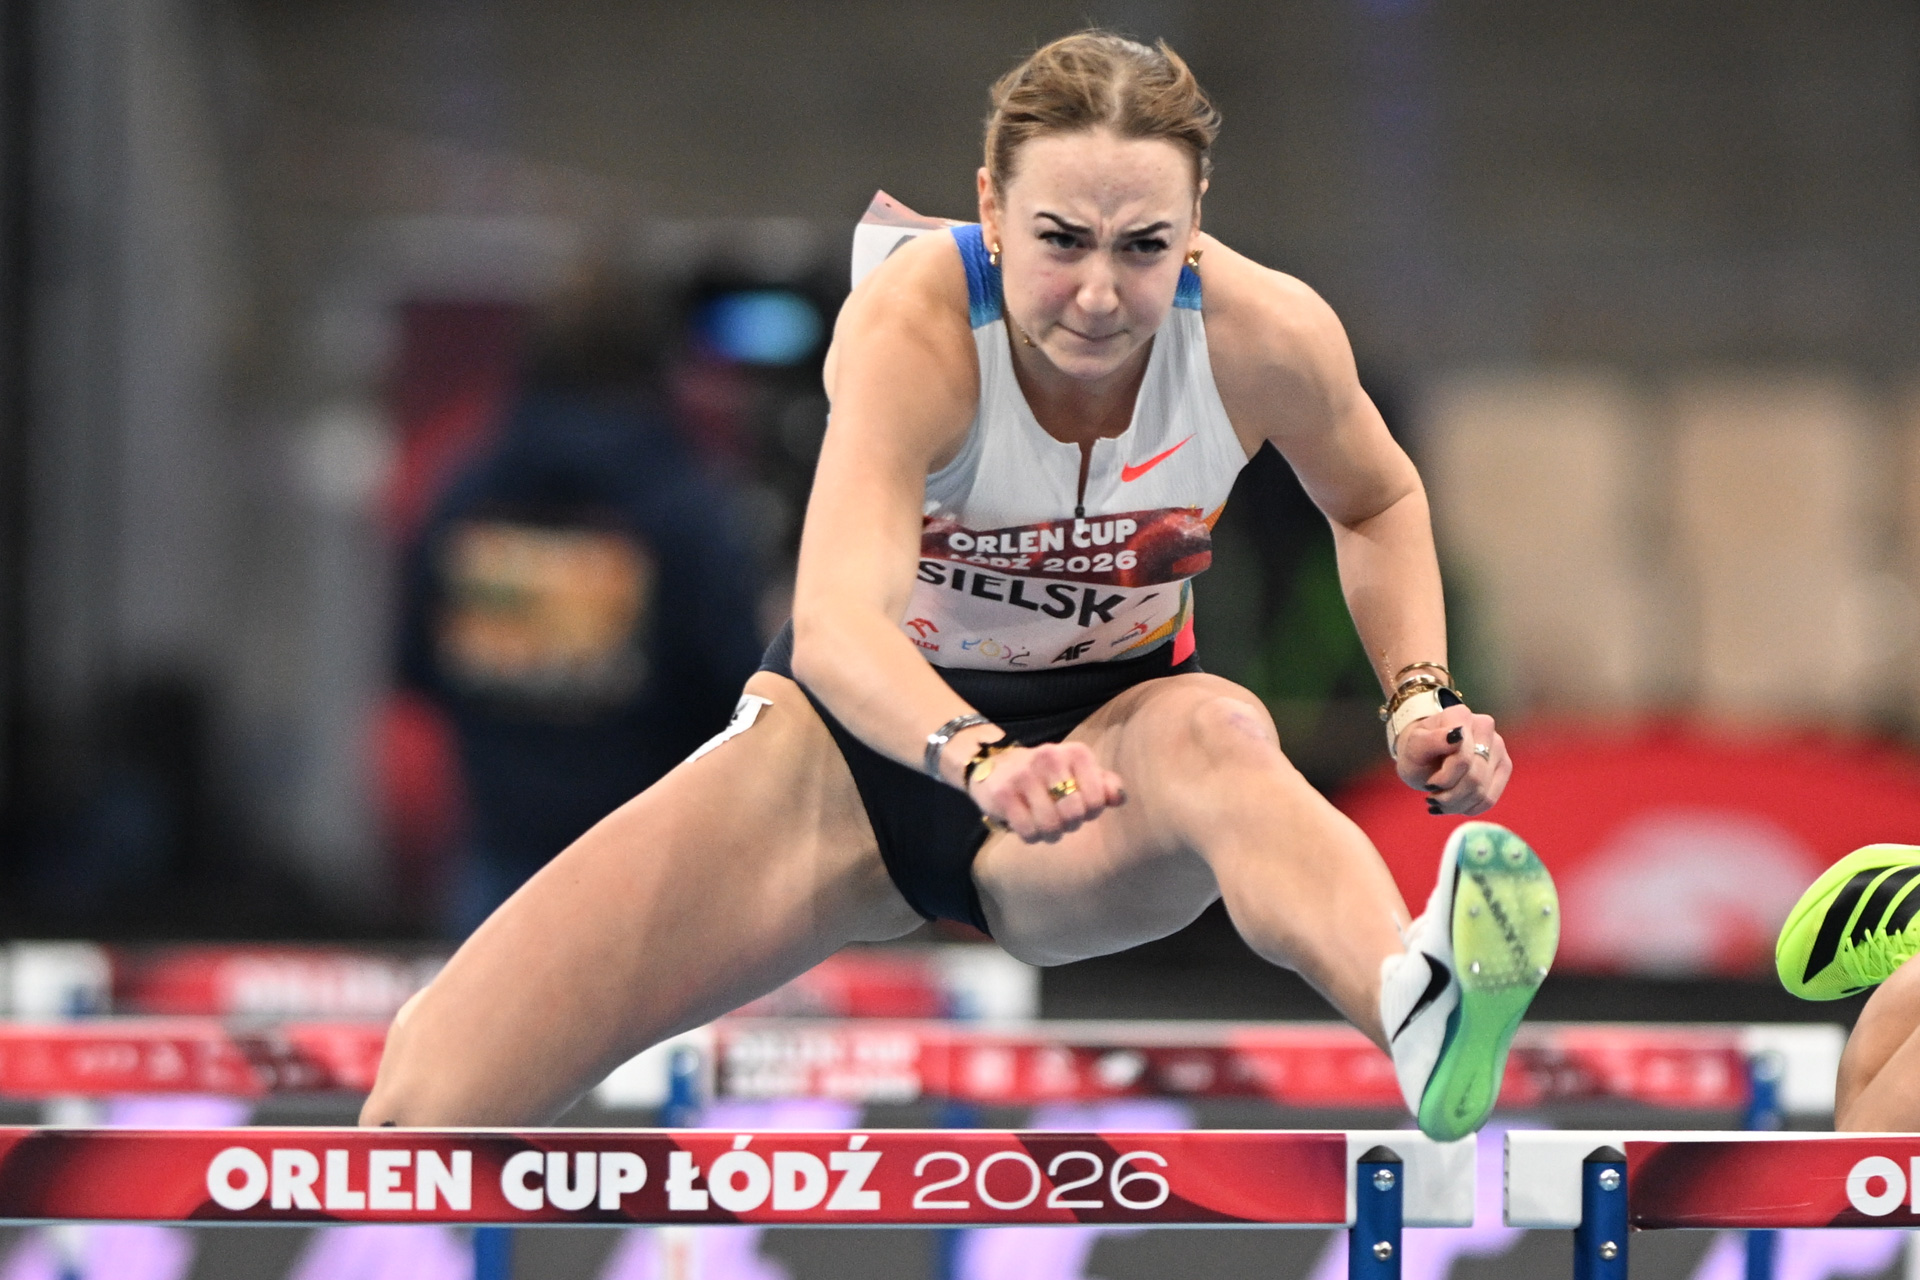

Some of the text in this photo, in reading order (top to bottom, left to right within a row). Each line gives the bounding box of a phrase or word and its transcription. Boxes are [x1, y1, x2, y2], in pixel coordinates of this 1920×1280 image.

[949, 518, 1137, 554] ORLEN CUP
[1043, 550, 1137, 572] 2026
[917, 560, 1159, 627] SIELSK
[206, 1134, 1170, 1211] ORLEN CUP ŁÓDŹ 2026
[1845, 1155, 1920, 1217] O
